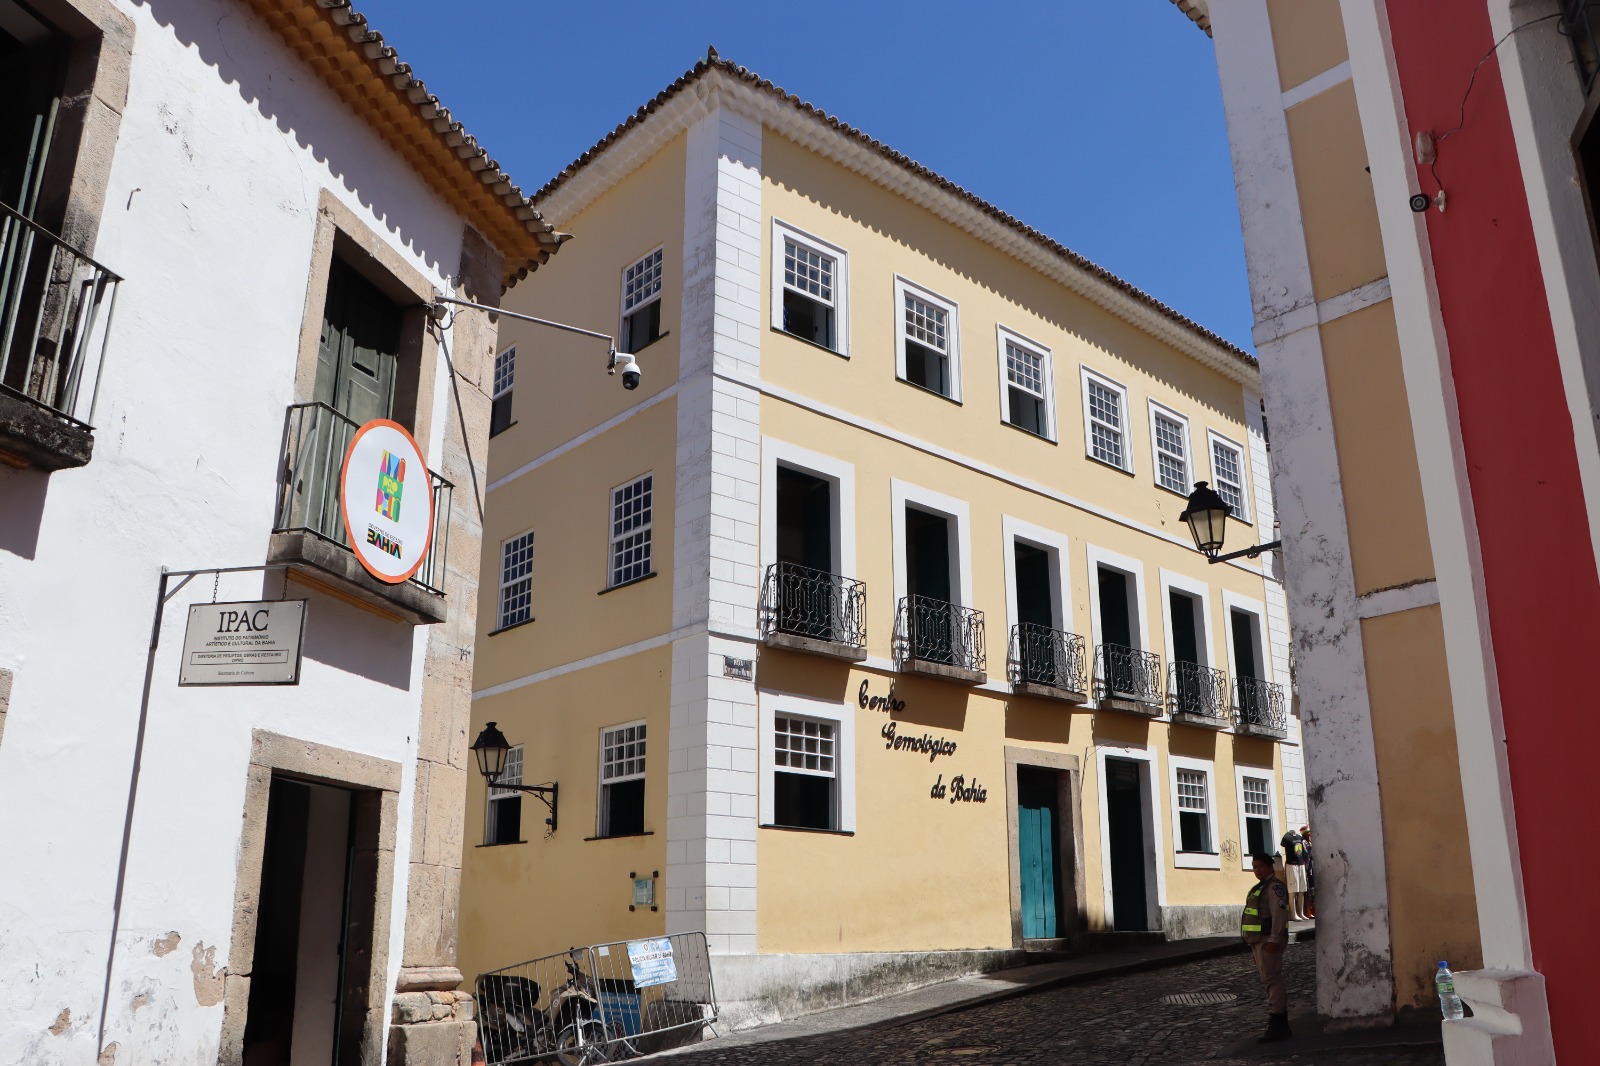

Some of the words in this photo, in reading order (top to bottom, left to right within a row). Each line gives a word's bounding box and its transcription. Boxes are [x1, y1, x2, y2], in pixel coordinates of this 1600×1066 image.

[367, 528, 402, 560] BAHIA
[217, 609, 269, 633] IPAC
[858, 679, 906, 712] Centro
[881, 722, 957, 763] Gemológico
[930, 773, 947, 799] da
[950, 774, 988, 804] Bahia
